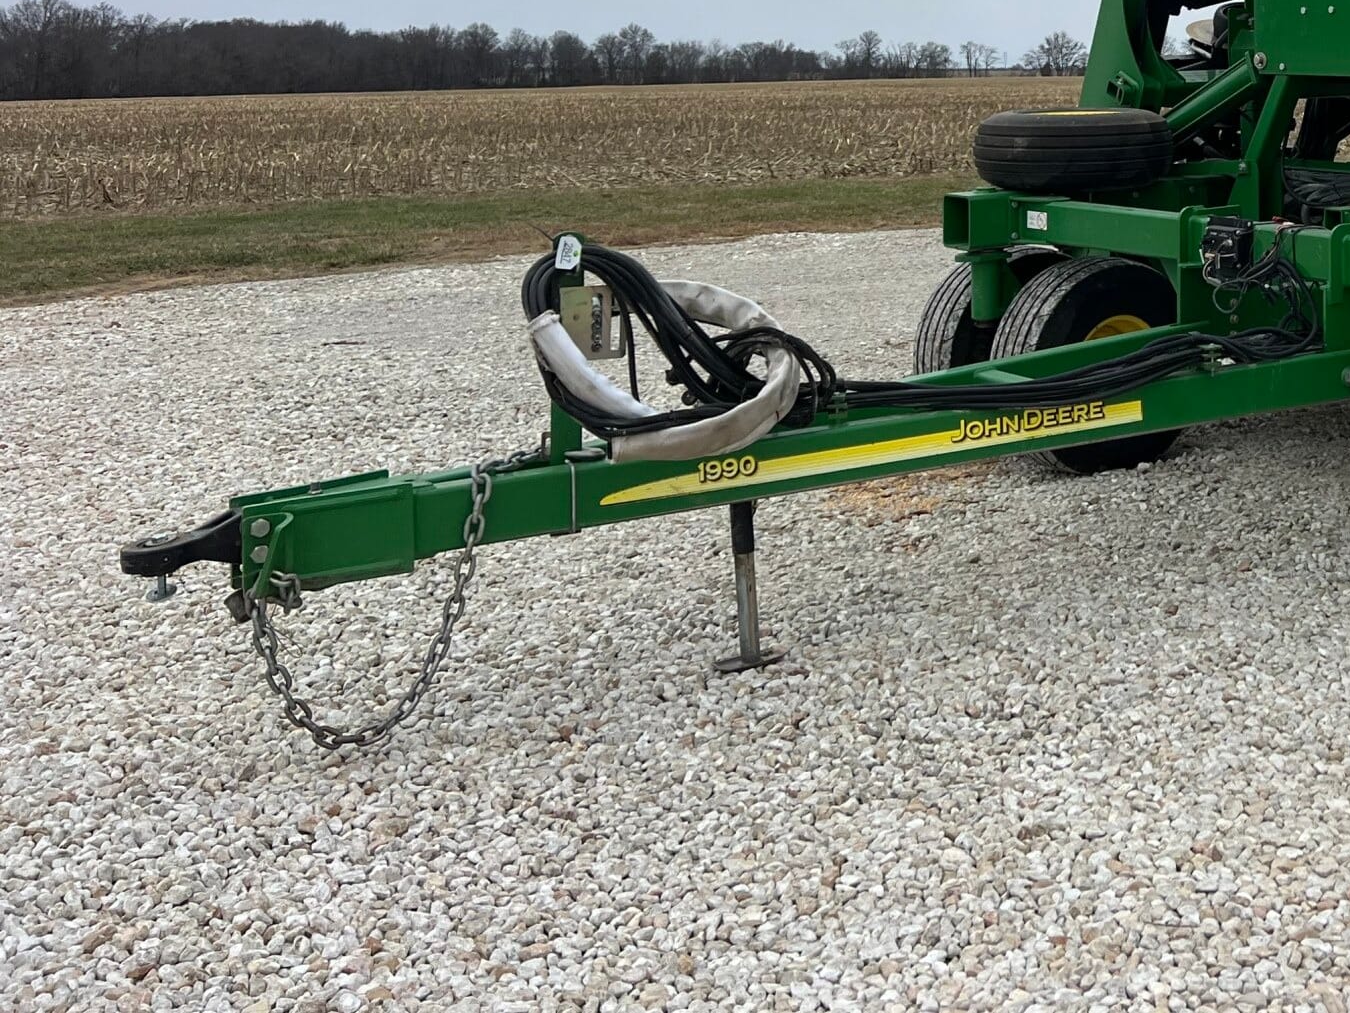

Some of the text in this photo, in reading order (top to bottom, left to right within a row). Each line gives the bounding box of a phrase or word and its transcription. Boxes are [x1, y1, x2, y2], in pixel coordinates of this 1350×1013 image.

[951, 400, 1105, 443] JOHN DEERE
[698, 455, 758, 484] 1990
